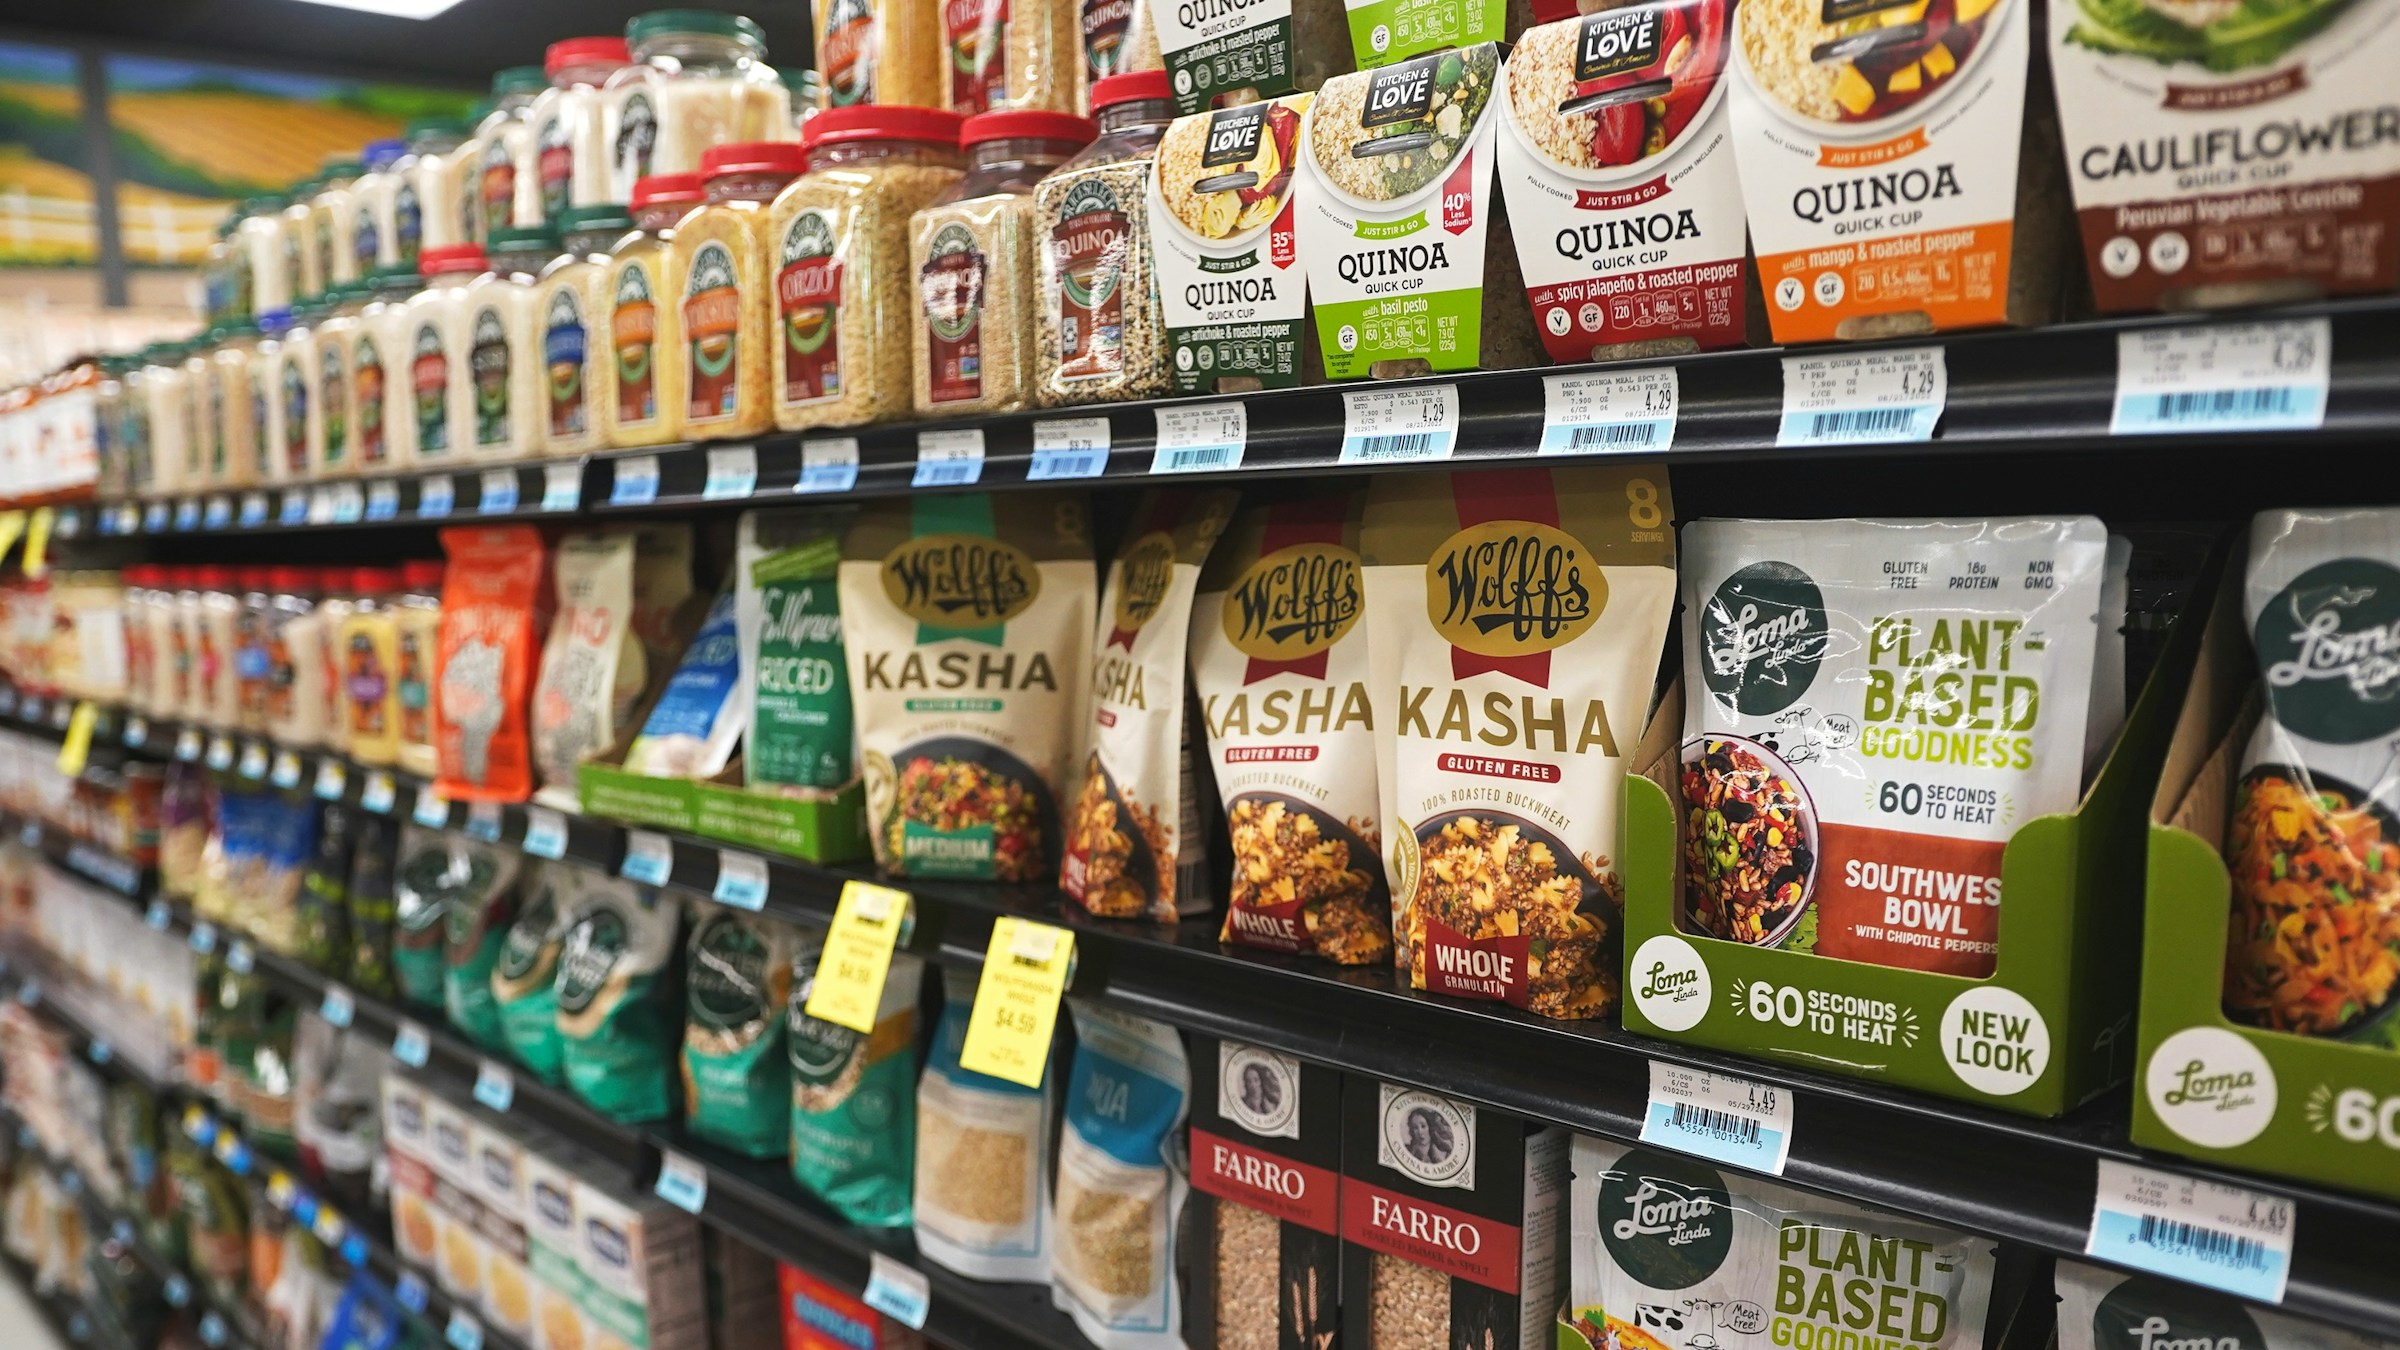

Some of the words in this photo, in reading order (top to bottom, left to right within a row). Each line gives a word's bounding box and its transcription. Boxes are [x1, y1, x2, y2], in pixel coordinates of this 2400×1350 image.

[1229, 16, 1246, 28] CUP
[1589, 13, 1641, 36] KITCHEN
[1643, 10, 1654, 21] &
[1585, 21, 1654, 62] LOVE
[1377, 70, 1418, 88] KITCHEN
[1421, 68, 1430, 78] &
[1371, 80, 1429, 111] LOVE
[1214, 117, 1251, 131] KITCHEN
[1251, 115, 1259, 124] &
[1210, 126, 1258, 152] LOVE
[2081, 104, 2400, 182] CAULIFLOWER
[1670, 165, 1694, 184] SPOON
[1694, 133, 1724, 166] INCLUDED
[1444, 193, 1472, 211] 40%
[1527, 175, 1544, 190] FULLY
[1546, 186, 1573, 201] COOKED
[1586, 196, 1608, 206] JUST
[1611, 194, 1633, 206] STIR
[1634, 192, 1641, 202] &
[1643, 186, 1658, 198] GO
[1793, 163, 1962, 223] QUINOA
[1318, 205, 1332, 219] FULLY
[1332, 216, 1353, 230] COOKED
[1363, 227, 1380, 235] JUST
[1382, 226, 1398, 235] STIR
[1400, 224, 1405, 232] &
[1407, 221, 1418, 230] GO
[1834, 216, 1884, 236] QUICK
[1890, 211, 1923, 227] CUP
[2116, 204, 2193, 230] Peruvian
[1556, 209, 1701, 260] QUINOA
[1809, 246, 1854, 268] mango
[1858, 242, 1868, 261] &
[1870, 236, 1921, 260] roasted
[1924, 230, 1976, 255] pepper
[1221, 260, 1235, 269] STIR
[1338, 242, 1449, 284] QUINOA
[1592, 254, 1635, 271] QUICK
[1640, 250, 1668, 264] CUP
[1185, 277, 1276, 310] QUINOA
[1366, 281, 1399, 294] QUICK
[1402, 278, 1424, 289] CUP
[1535, 288, 1554, 304] with
[1557, 285, 1584, 303] spicy
[1586, 276, 1635, 300] jalapeño
[1637, 273, 1646, 290] &
[1650, 267, 1693, 288] roasted
[1695, 262, 1739, 286] pepper
[1705, 288, 1720, 300] NET
[1720, 286, 1733, 299] WT
[1822, 284, 1838, 296] GF
[1207, 310, 1234, 320] QUICK
[1237, 309, 1255, 318] CUP
[1381, 300, 1400, 315] basil
[1404, 297, 1428, 315] pesto
[1585, 312, 1598, 323] GF
[1615, 305, 1630, 319] 220
[1708, 312, 1731, 326] (225g)
[1718, 300, 1729, 311] OZ
[1262, 324, 1290, 338] pepper
[1586, 379, 1612, 387] QUINOA
[1619, 385, 1640, 393] 0.543
[1902, 370, 1934, 394] 4.29
[1422, 404, 1445, 423] 4.29
[1645, 389, 1672, 410] 4.29
[1626, 478, 1662, 529] 8
[1630, 531, 1664, 544] SERVINGS
[889, 544, 1030, 618] Wolff's
[1883, 561, 1929, 575] GLUTEN
[1966, 561, 1986, 574] 18g
[2028, 560, 2054, 574] NON
[1437, 535, 1590, 642] Wolff's
[1890, 575, 1918, 590] FREE
[1948, 576, 2000, 590] PROTEIN
[2024, 575, 2054, 590] GMO
[1233, 555, 1358, 645] Wolff's
[1714, 603, 1809, 669] Loma
[1868, 616, 2046, 672] PLANT-
[1764, 641, 1806, 668] Linda
[759, 656, 834, 695] RICED
[864, 651, 1058, 691] KASHA
[1205, 681, 1374, 741] KASHA
[1864, 668, 2040, 732] BASED
[1398, 685, 1621, 758] KASHA
[1228, 747, 1274, 762] GLUTEN
[1278, 746, 1312, 761] FREE
[1860, 730, 2034, 770] GOODNESS
[1447, 757, 1505, 774] GLUTEN
[1512, 764, 1550, 780] FREE
[1422, 792, 1447, 813] 100%
[1452, 788, 1500, 802] ROASTED
[1506, 791, 1571, 831] BUCKWHEAT
[1879, 780, 1923, 815] 60
[1927, 784, 1997, 805] SECONDS
[1926, 802, 1946, 819] TO
[1954, 805, 1995, 824] HEAT
[906, 837, 991, 860] MEDIUM
[1845, 859, 2002, 907] SOUTHWES
[1232, 906, 1300, 940] WHOLE
[1884, 896, 1968, 935] BOWL
[1855, 924, 1883, 940] WITH
[1886, 930, 1941, 949] CHIPOTLE
[1944, 939, 1998, 954] PEPPERS
[1640, 961, 1698, 1000] Loma
[1672, 987, 1699, 1003] Linda
[1748, 980, 1806, 1028] 60
[1808, 989, 1898, 1022] SECONDS
[1808, 1010, 1836, 1035] TO
[1843, 1016, 1898, 1046] HEAT
[1961, 1007, 2031, 1045] NEW
[1955, 1040, 2035, 1076] LOOK
[1667, 1071, 1693, 1081] 10.000
[1701, 1078, 1710, 1086] OZ
[1671, 1080, 1689, 1089] 6/CS
[2165, 1059, 2256, 1106] Loma
[1396, 1096, 1426, 1110] KITCHEN
[1429, 1099, 1439, 1107] OF
[1441, 1104, 1459, 1125] LOVE
[1662, 1086, 1692, 1097] 0302037
[1728, 1100, 1774, 1116] 05/29/2022
[1748, 1088, 1776, 1110] 4.49
[1664, 1118, 1670, 1127] 8
[1680, 1123, 1709, 1136] 45561
[1714, 1131, 1746, 1145] 00134
[1756, 1141, 1762, 1149] 5
[2333, 1088, 2400, 1150] 60
[1213, 1144, 1305, 1200] FARRO
[1371, 1195, 1480, 1255] FARRO
[1613, 1183, 1712, 1240] Loma
[2250, 1201, 2288, 1230] 4.49
[1668, 1224, 1712, 1246] Linda
[1778, 1218, 1954, 1288] PLANT-
[1732, 1304, 1760, 1322] Meat
[1774, 1264, 1947, 1344] BASED
